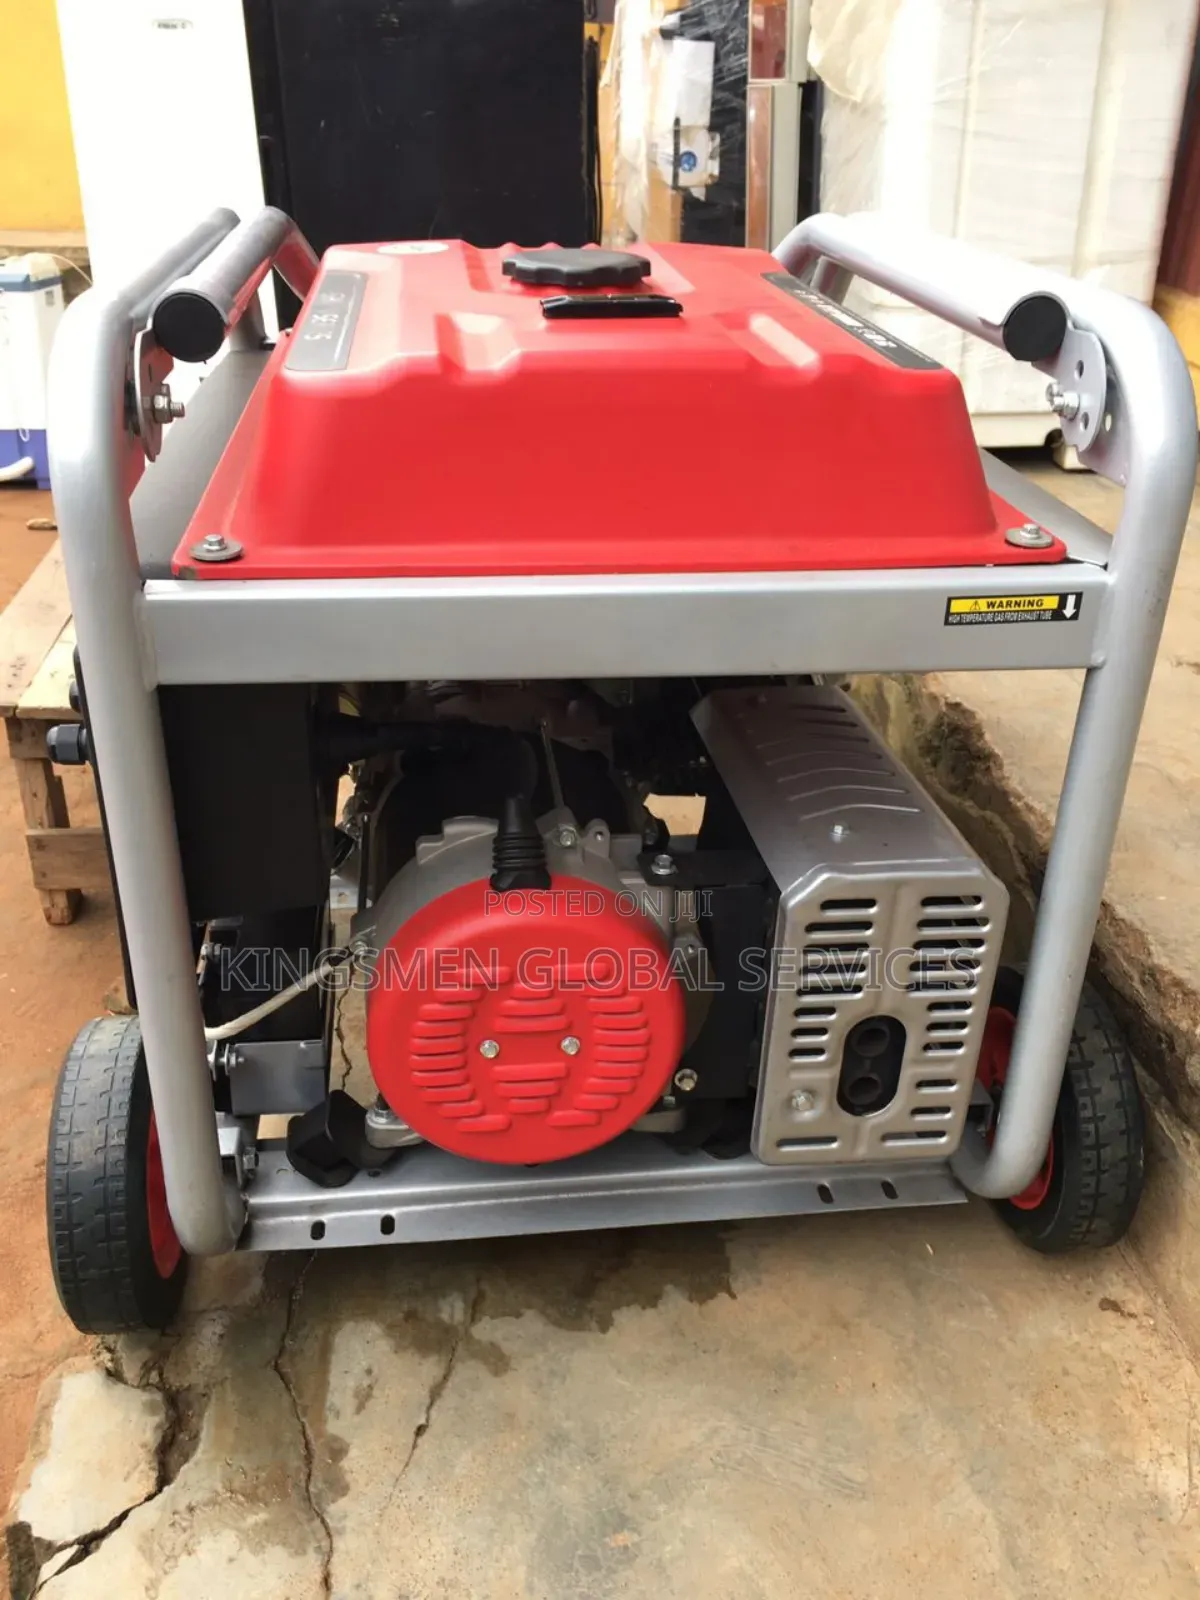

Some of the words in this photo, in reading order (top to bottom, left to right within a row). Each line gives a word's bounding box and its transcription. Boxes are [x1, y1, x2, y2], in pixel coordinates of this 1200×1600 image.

[986, 599, 1044, 609] WARNING
[961, 612, 994, 623] TEMPERATURE
[994, 612, 1005, 622] GAS
[1005, 611, 1018, 621] FROM
[1018, 610, 1038, 621] EXHAUST
